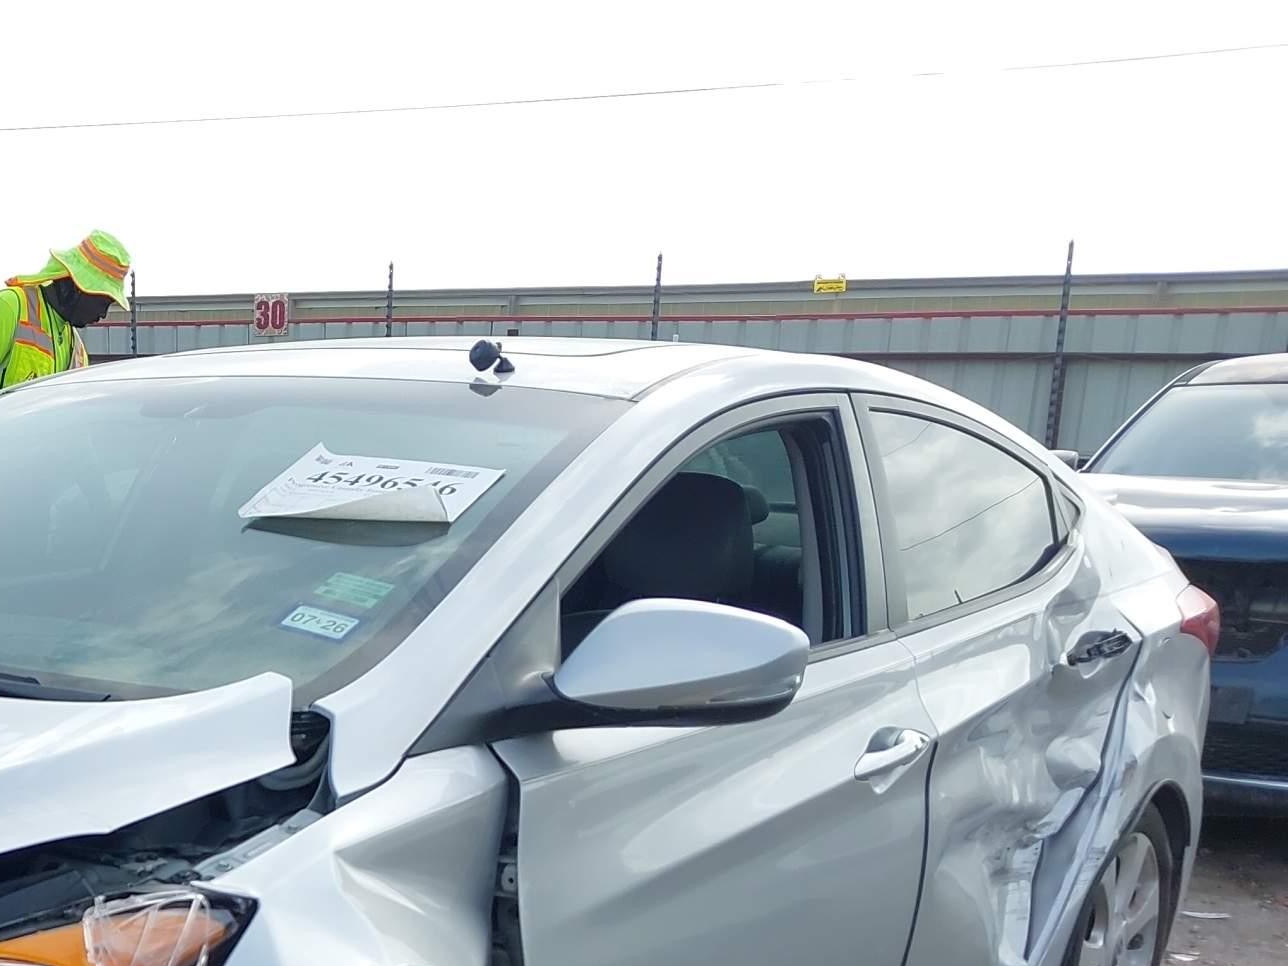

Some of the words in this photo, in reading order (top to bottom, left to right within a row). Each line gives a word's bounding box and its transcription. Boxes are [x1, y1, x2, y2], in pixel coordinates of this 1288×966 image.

[255, 300, 285, 330] 30
[290, 612, 318, 625] 07
[319, 619, 349, 634] 26
